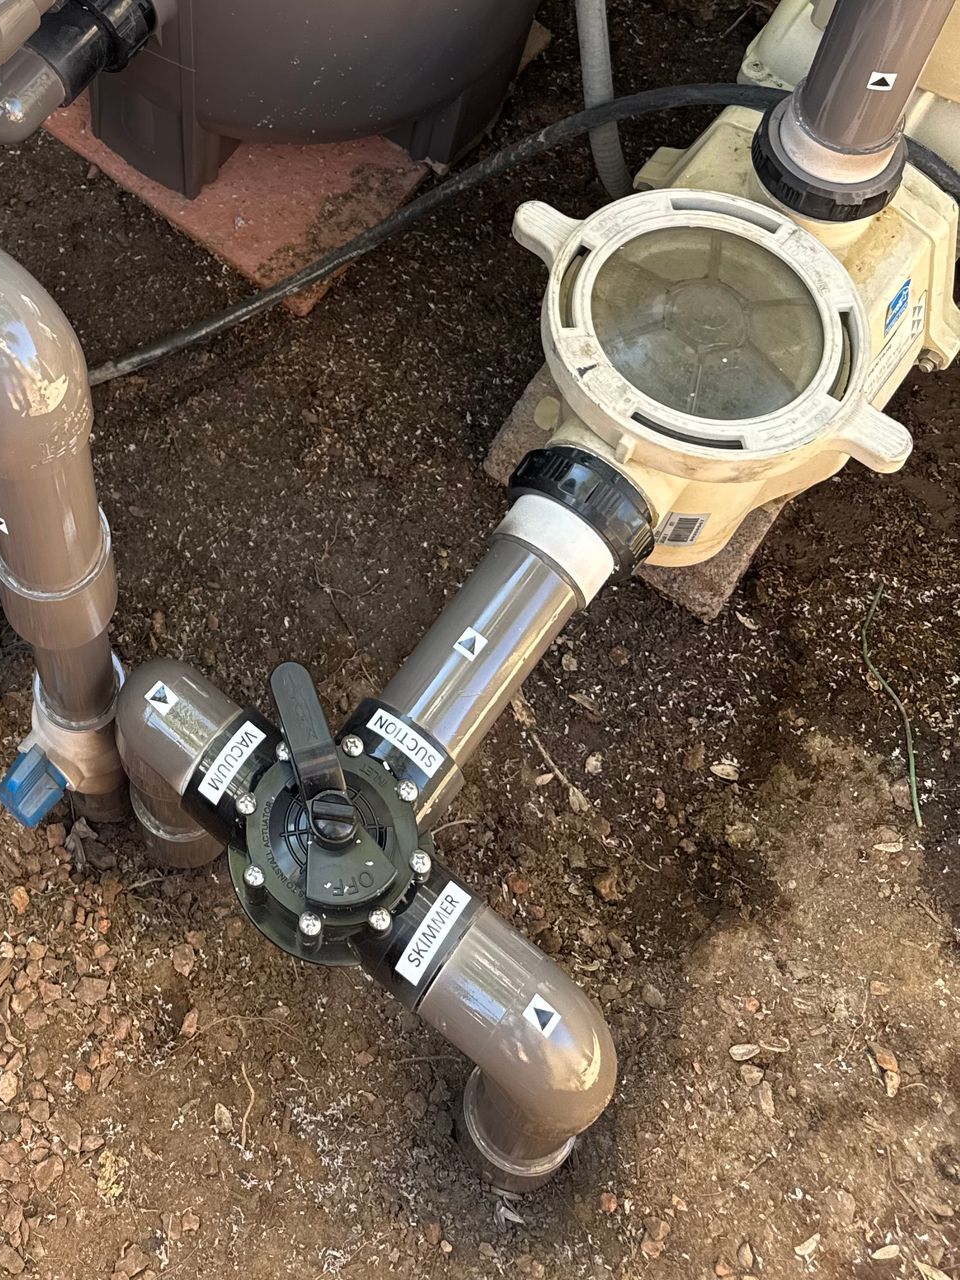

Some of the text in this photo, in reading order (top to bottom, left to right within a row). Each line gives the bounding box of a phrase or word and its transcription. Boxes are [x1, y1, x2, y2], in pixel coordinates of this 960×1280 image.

[211, 730, 257, 793] VACUUM
[372, 715, 440, 767] SUCTION
[261, 801, 274, 847] ACTUATOR
[265, 851, 288, 885] INSTALL
[332, 871, 374, 897] OFF
[408, 893, 460, 969] SKIMMER
